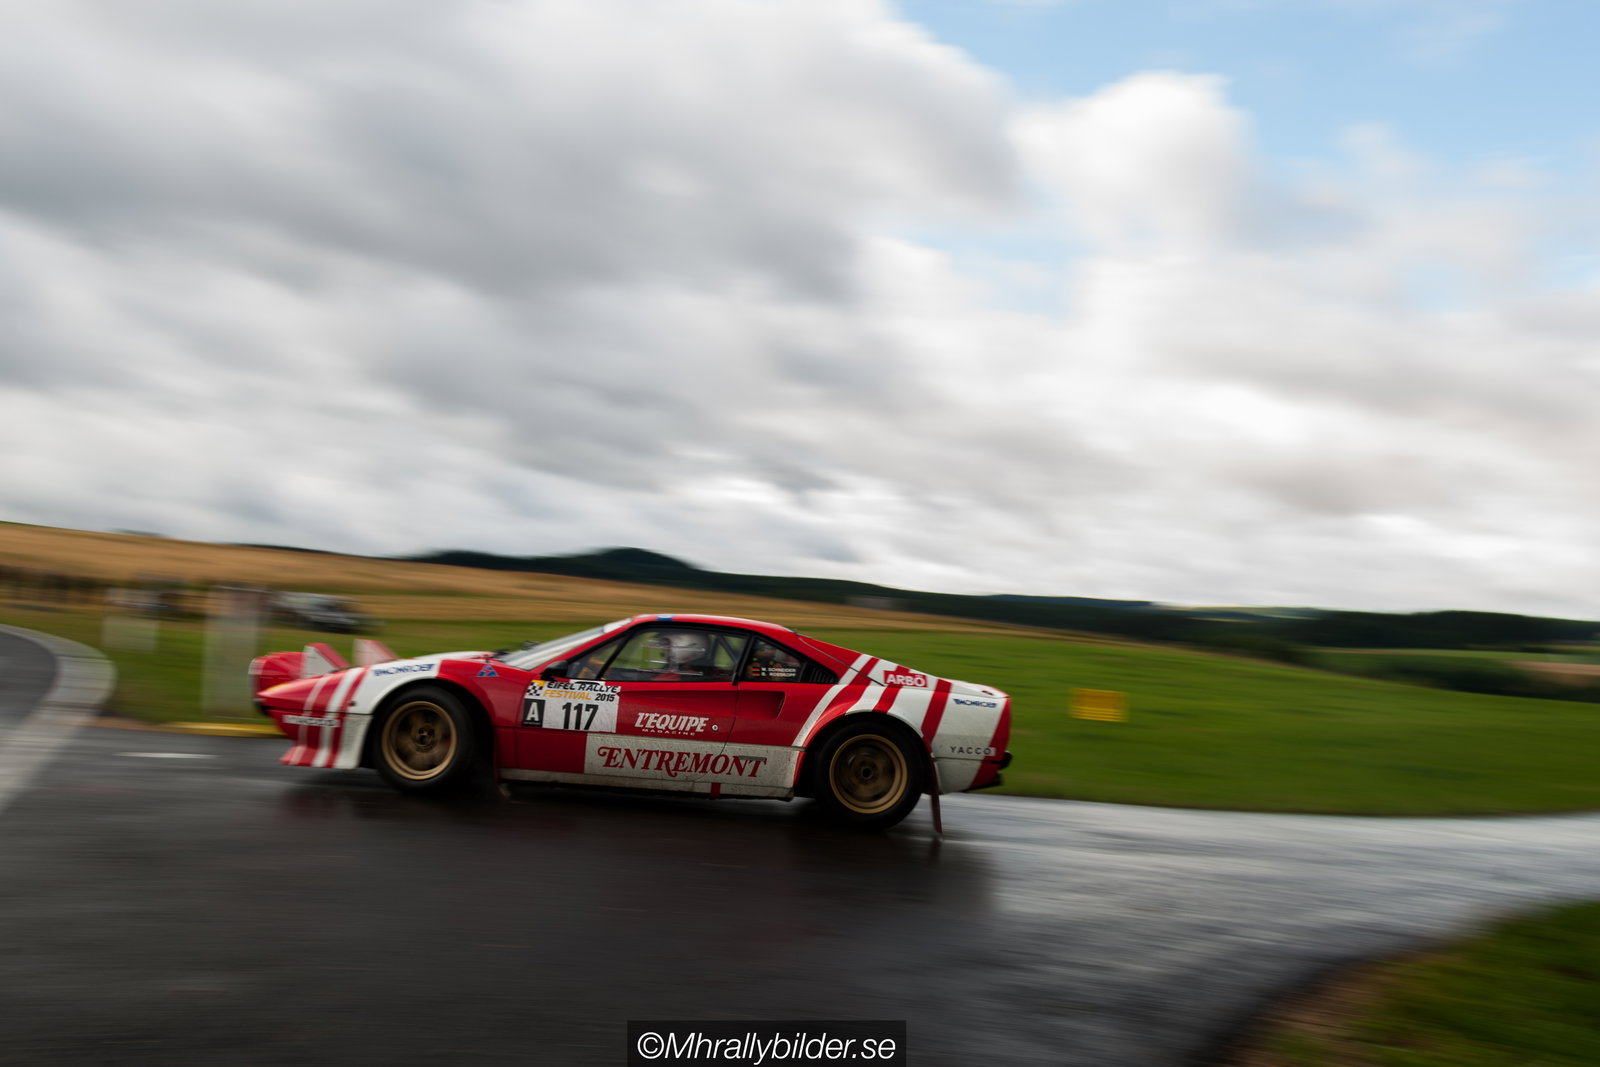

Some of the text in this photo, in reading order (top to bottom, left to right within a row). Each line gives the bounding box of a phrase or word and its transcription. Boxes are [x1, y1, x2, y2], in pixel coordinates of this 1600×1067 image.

[546, 681, 619, 694] EIFEL RALLYE
[543, 690, 615, 702] FESTIVAL 2015
[525, 701, 540, 721] A
[562, 702, 599, 730] 117
[950, 745, 992, 755] YACCO
[597, 746, 767, 777] ENTREMONT
